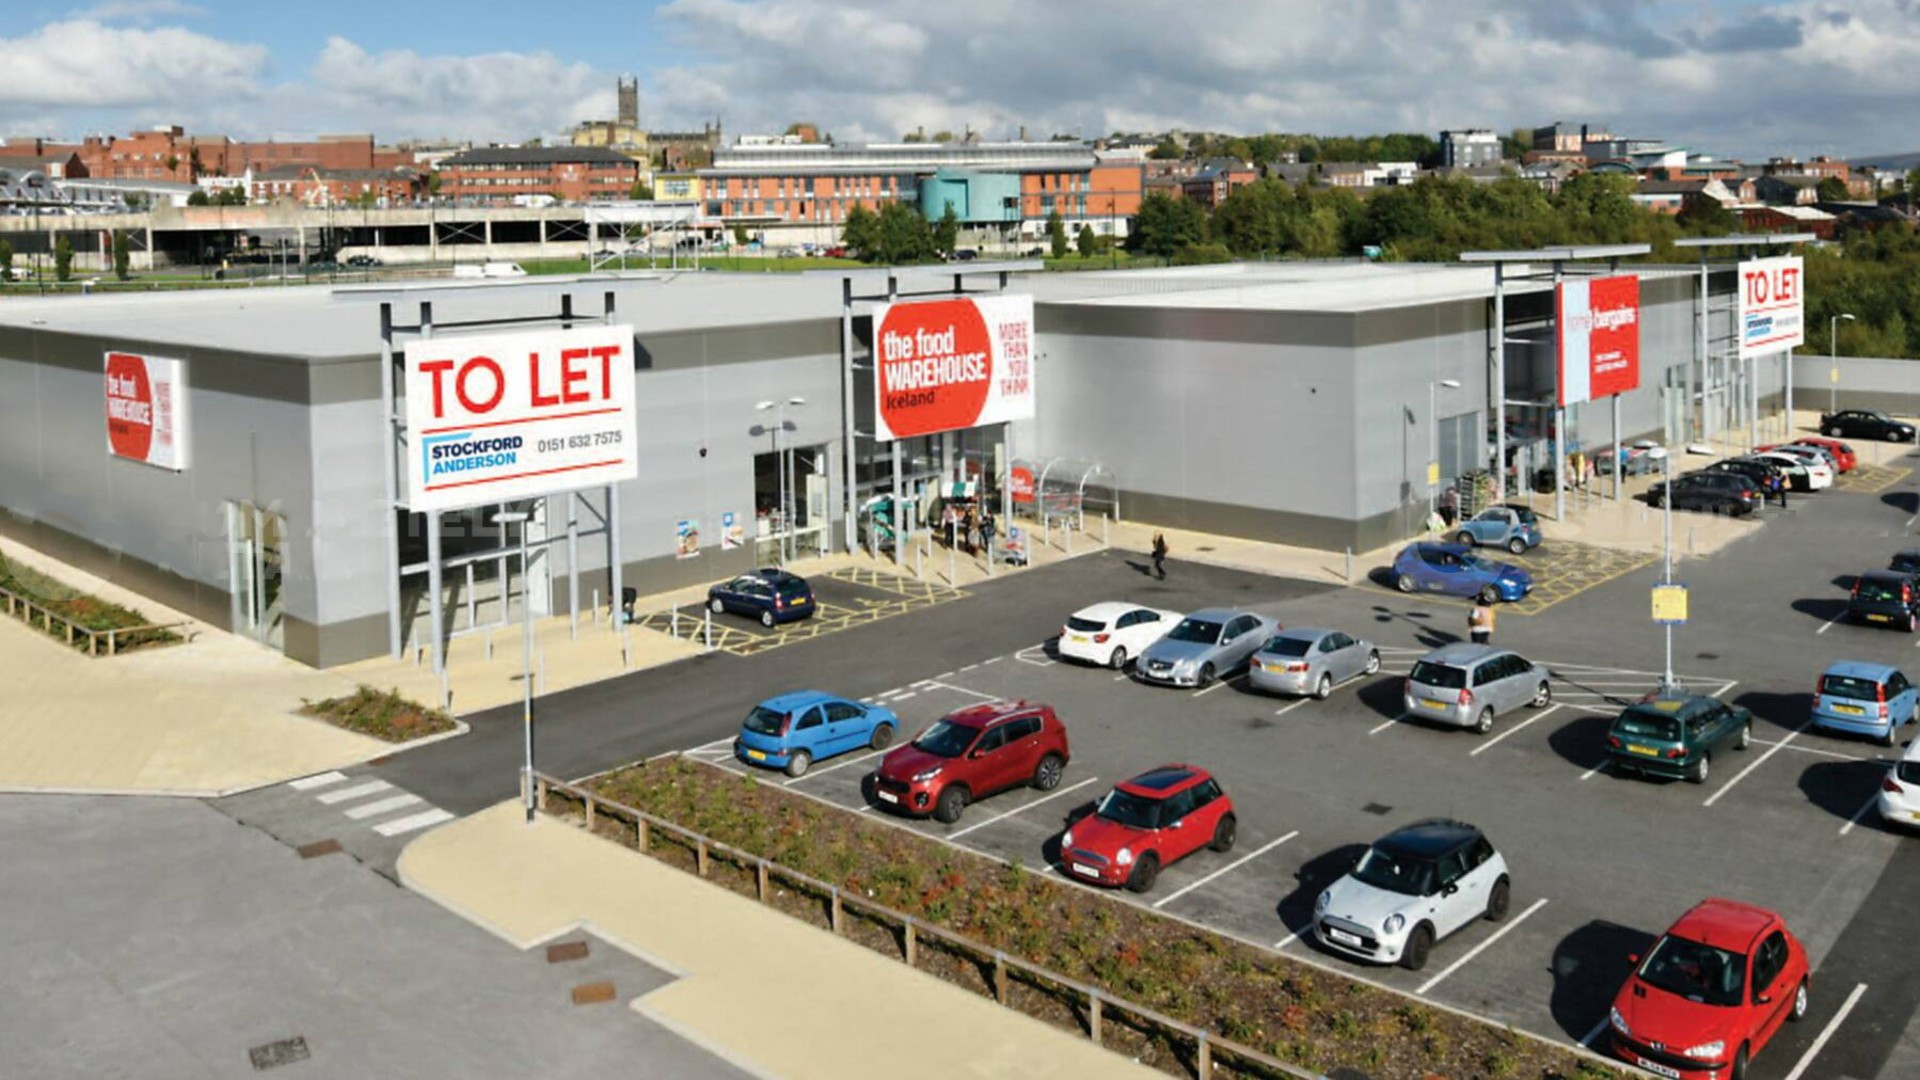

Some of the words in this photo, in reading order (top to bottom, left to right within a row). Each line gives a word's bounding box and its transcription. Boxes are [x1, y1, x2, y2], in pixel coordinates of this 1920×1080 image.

[1745, 270, 1768, 305] TO
[1773, 268, 1799, 301] LET
[883, 331, 913, 361] the
[917, 325, 955, 357] food
[419, 356, 505, 418] TO
[529, 346, 620, 407] LET
[885, 353, 987, 392] WAREHOUSE
[432, 436, 523, 460] STOCKFORD
[538, 438, 564, 453] 0151
[593, 430, 622, 445] 7575
[433, 452, 517, 475] ANDERSON
